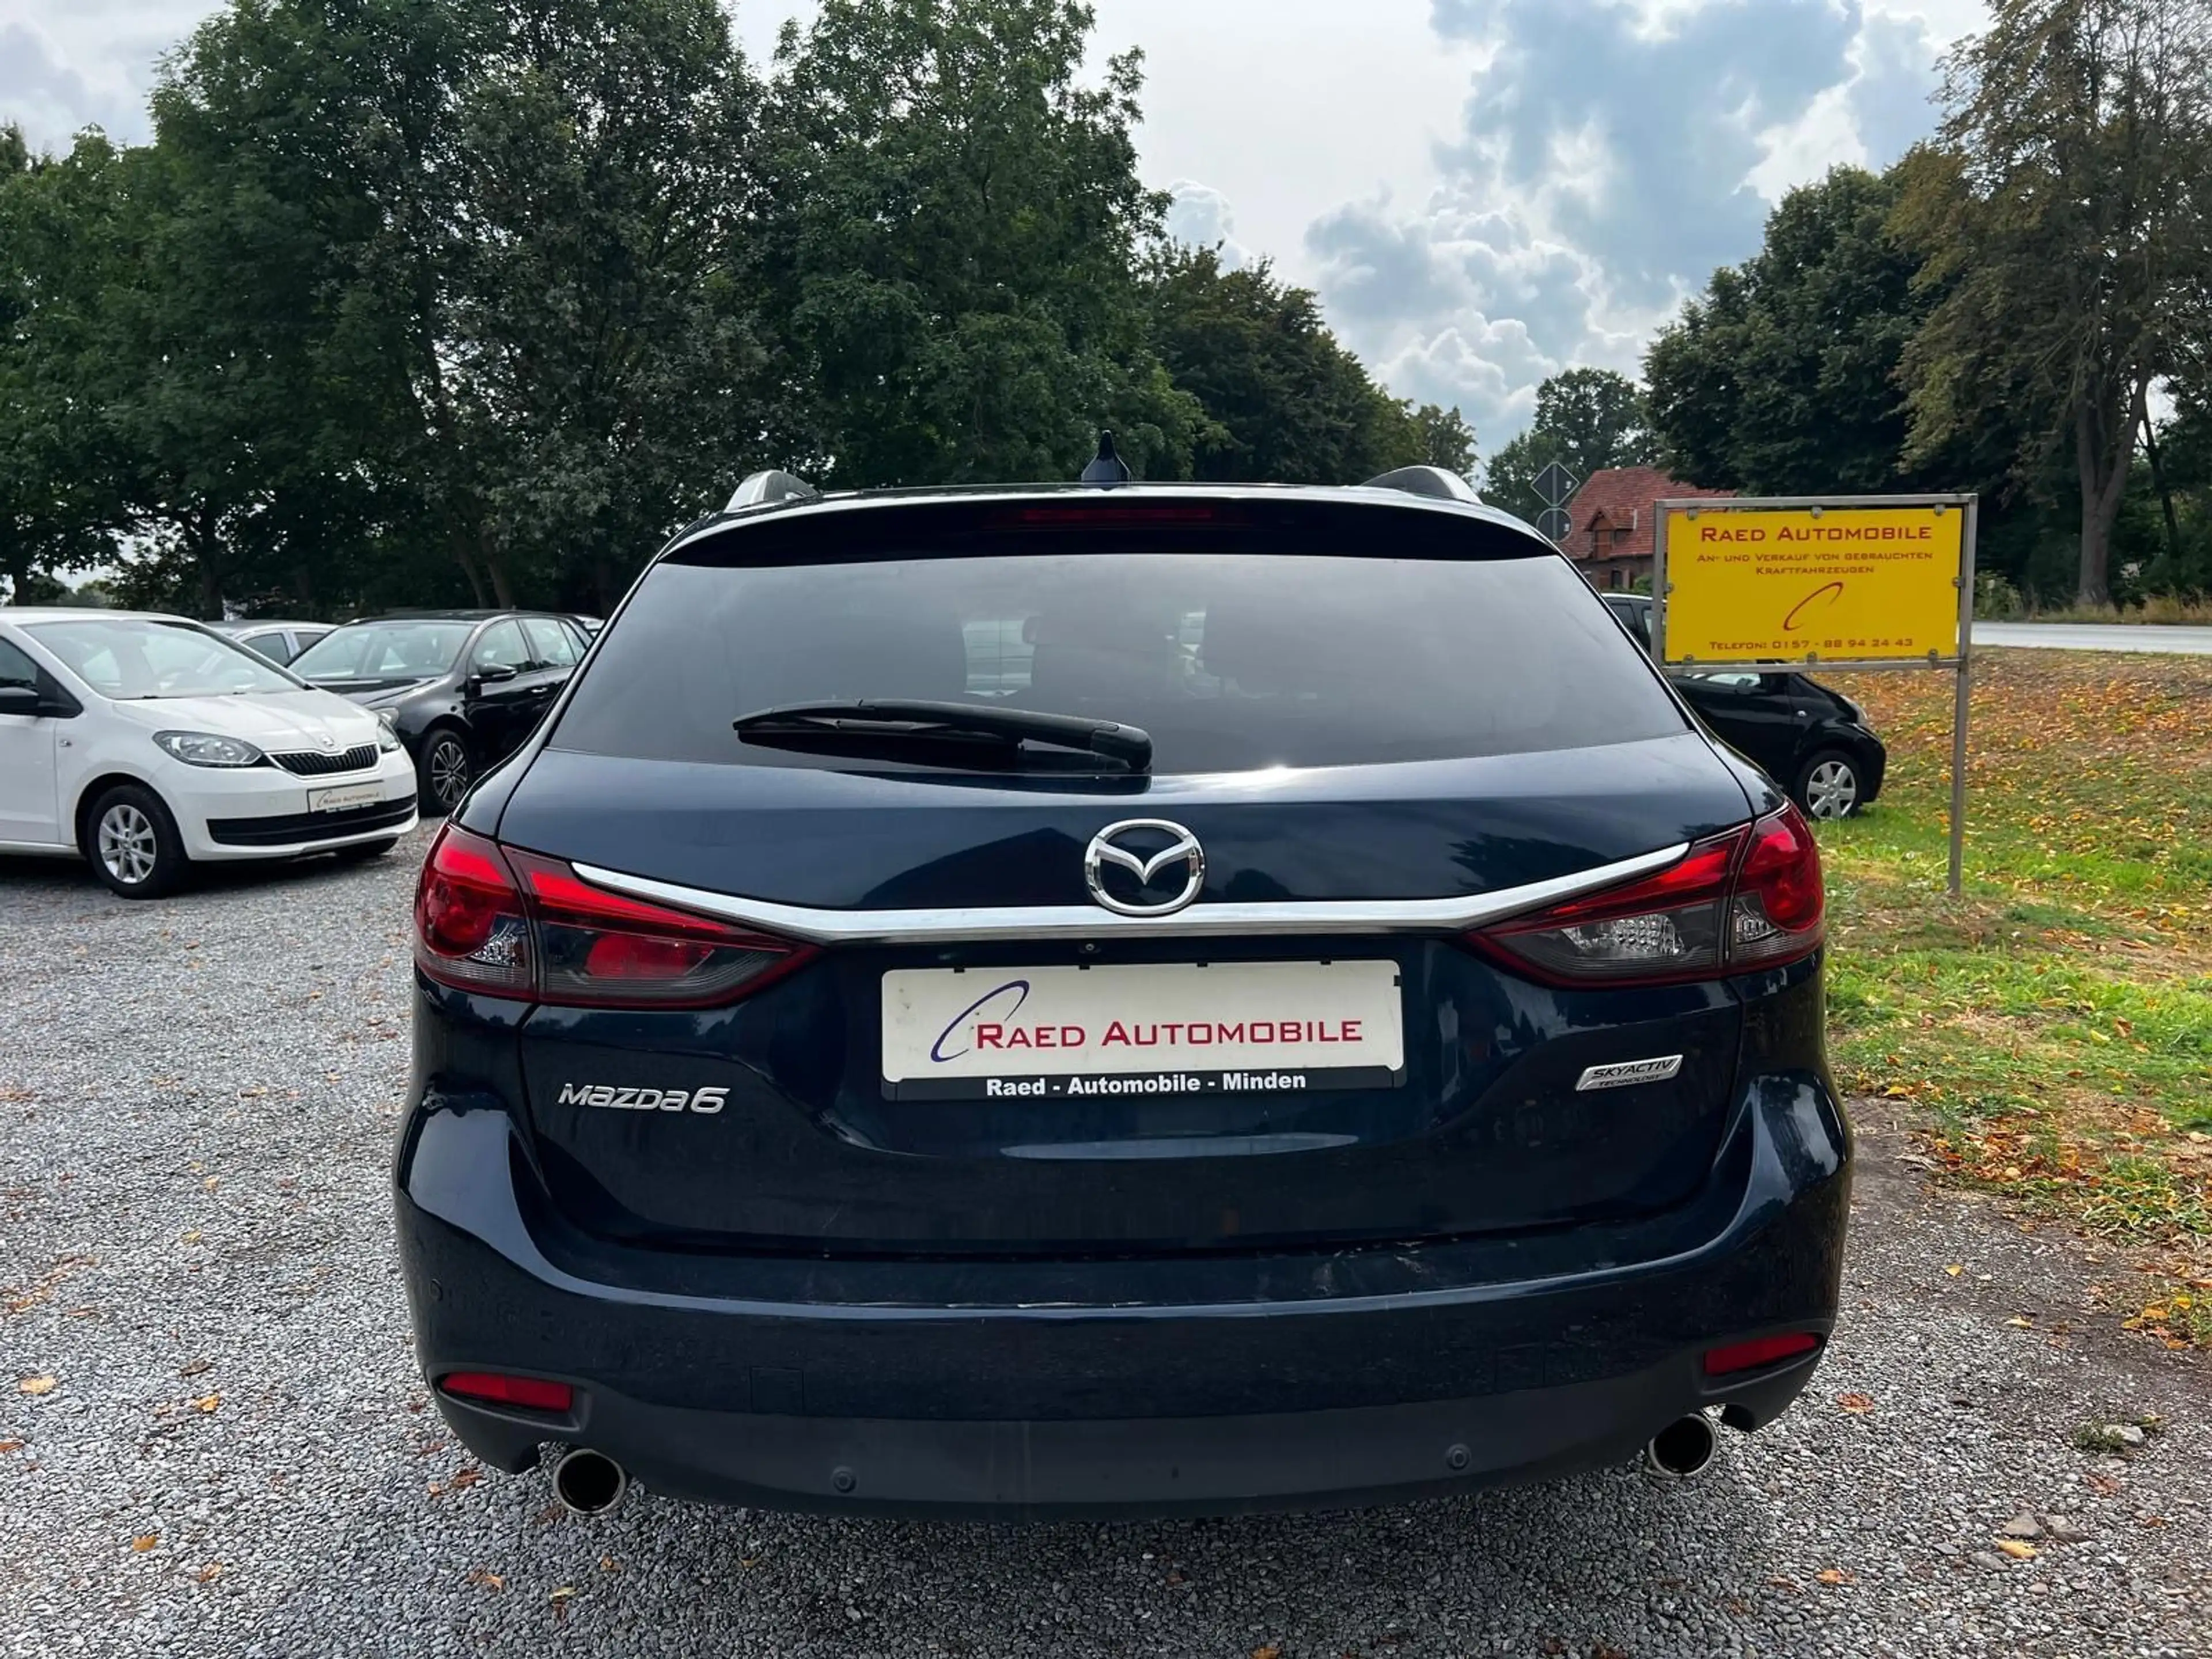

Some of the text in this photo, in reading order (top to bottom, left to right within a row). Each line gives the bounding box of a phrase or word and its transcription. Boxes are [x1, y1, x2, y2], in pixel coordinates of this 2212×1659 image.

[1701, 525, 1932, 542] RAED AUTOMOBILE
[1772, 639, 1810, 649] 0157
[1824, 639, 1842, 648] 88
[1847, 639, 1866, 647] 94
[1894, 638, 1913, 647] 43
[977, 1021, 1362, 1049] RAED AUTOMOBILE
[1592, 1059, 1673, 1078] SKYACTIV
[986, 1078, 1046, 1096] Raed
[1067, 1074, 1200, 1094] Automobile
[1222, 1072, 1306, 1090] Minden
